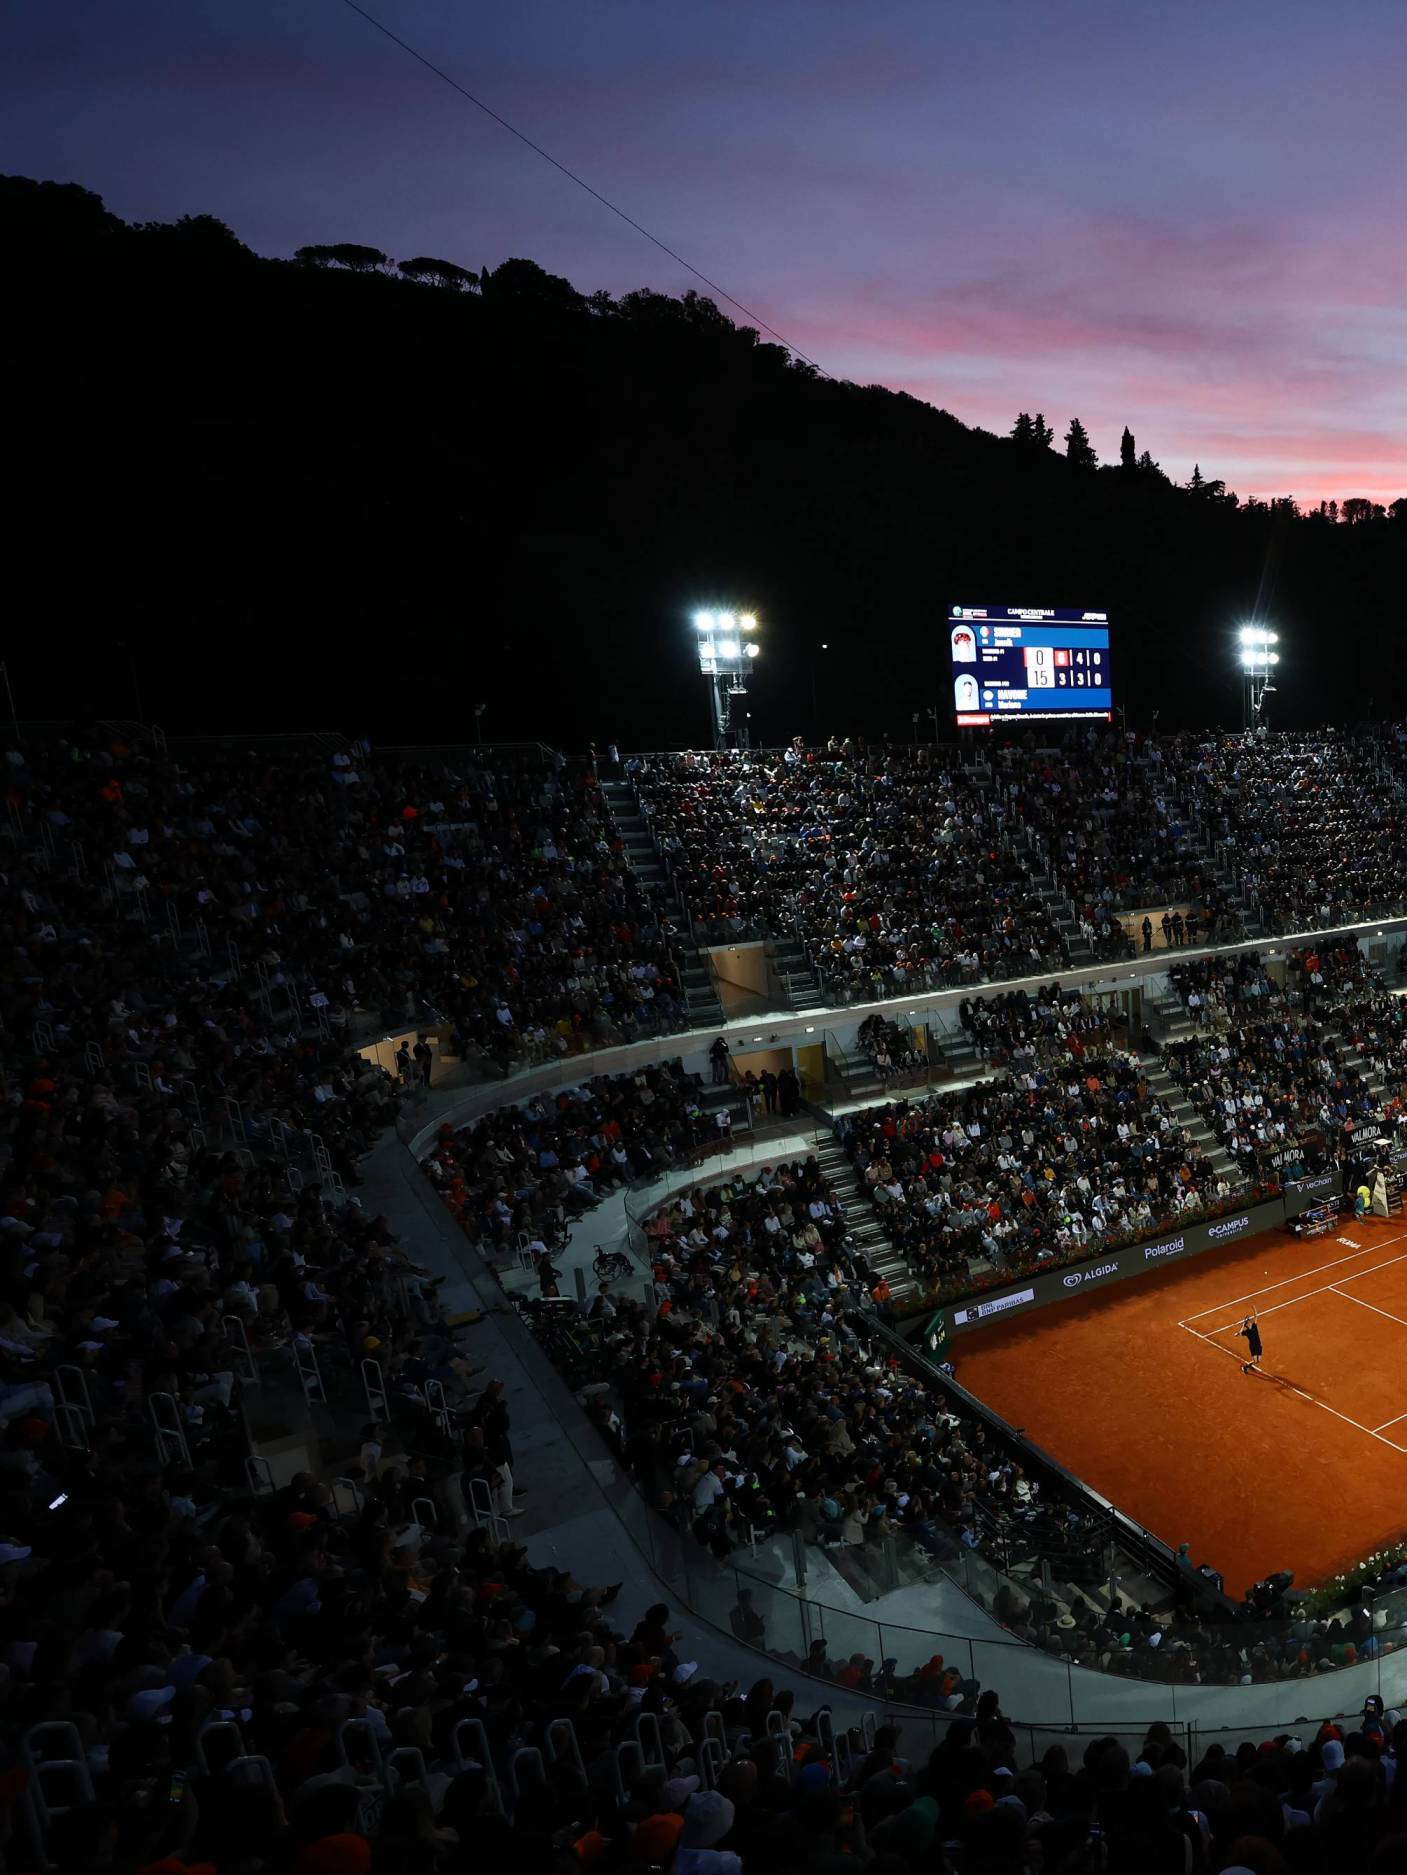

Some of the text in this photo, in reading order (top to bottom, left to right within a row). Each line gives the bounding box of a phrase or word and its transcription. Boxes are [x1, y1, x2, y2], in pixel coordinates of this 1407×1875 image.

[1036, 650, 1044, 666] 0
[1076, 652, 1084, 665] 4
[1093, 652, 1101, 665] 0
[1034, 670, 1048, 686] 15
[1059, 672, 1067, 686] 3
[1077, 672, 1085, 686] 3
[1351, 1126, 1382, 1143] VALMORA
[1271, 1149, 1305, 1168] VALMORA
[1208, 1217, 1249, 1238] eCAMPUS
[1144, 1237, 1184, 1260] Polaroid
[1336, 1237, 1361, 1249] ROMA
[1084, 1263, 1118, 1281] ALGIDA
